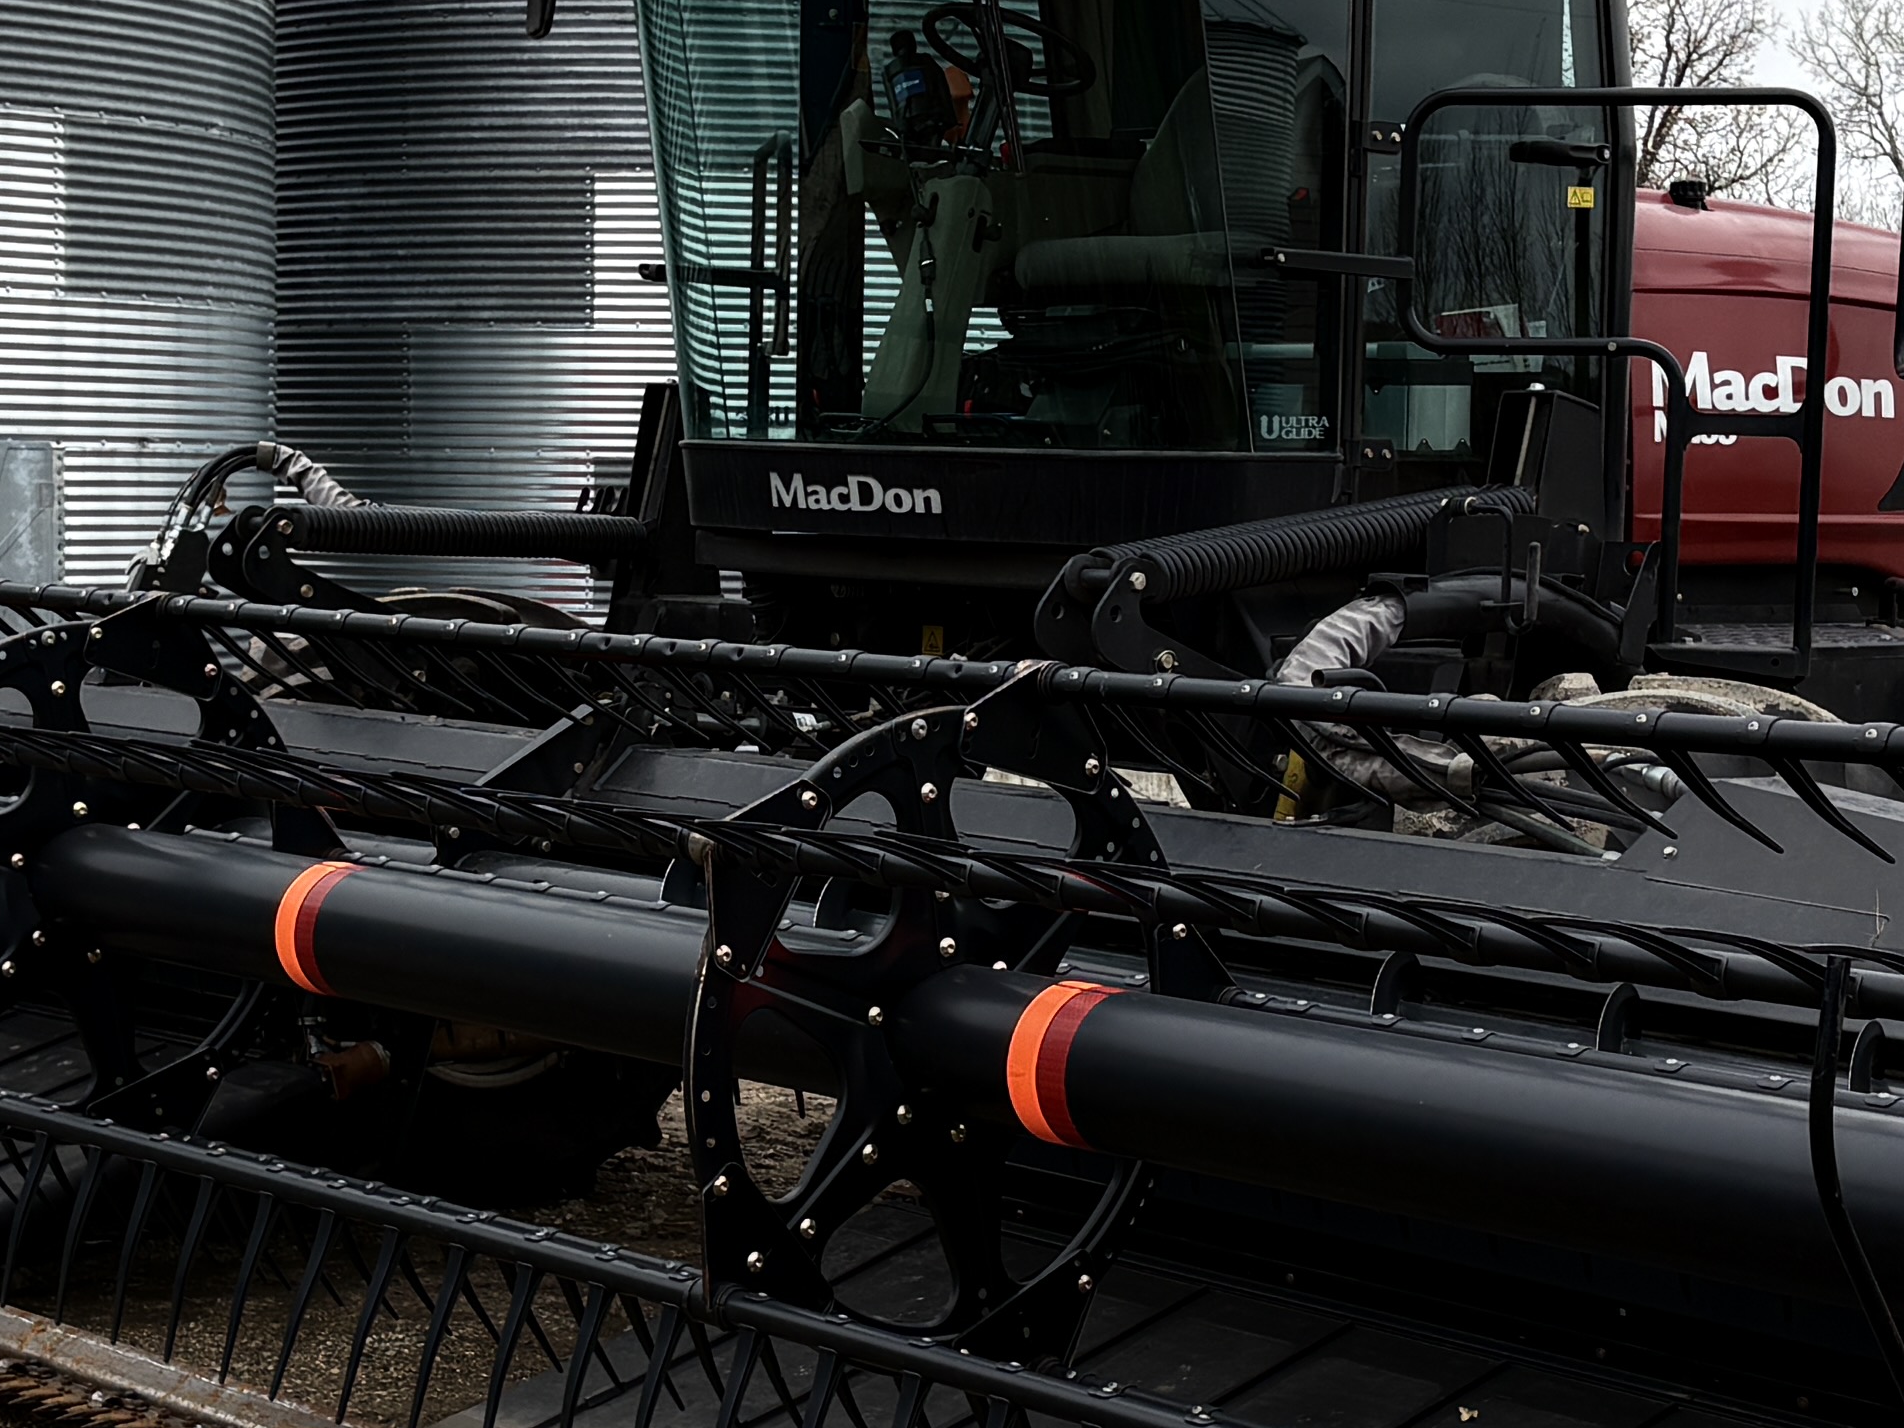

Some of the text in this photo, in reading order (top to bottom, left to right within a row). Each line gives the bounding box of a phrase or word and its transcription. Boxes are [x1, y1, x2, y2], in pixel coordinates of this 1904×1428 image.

[1281, 416, 1329, 427] ULTRA
[1281, 427, 1325, 439] GLIDE
[769, 471, 943, 514] MacDon
